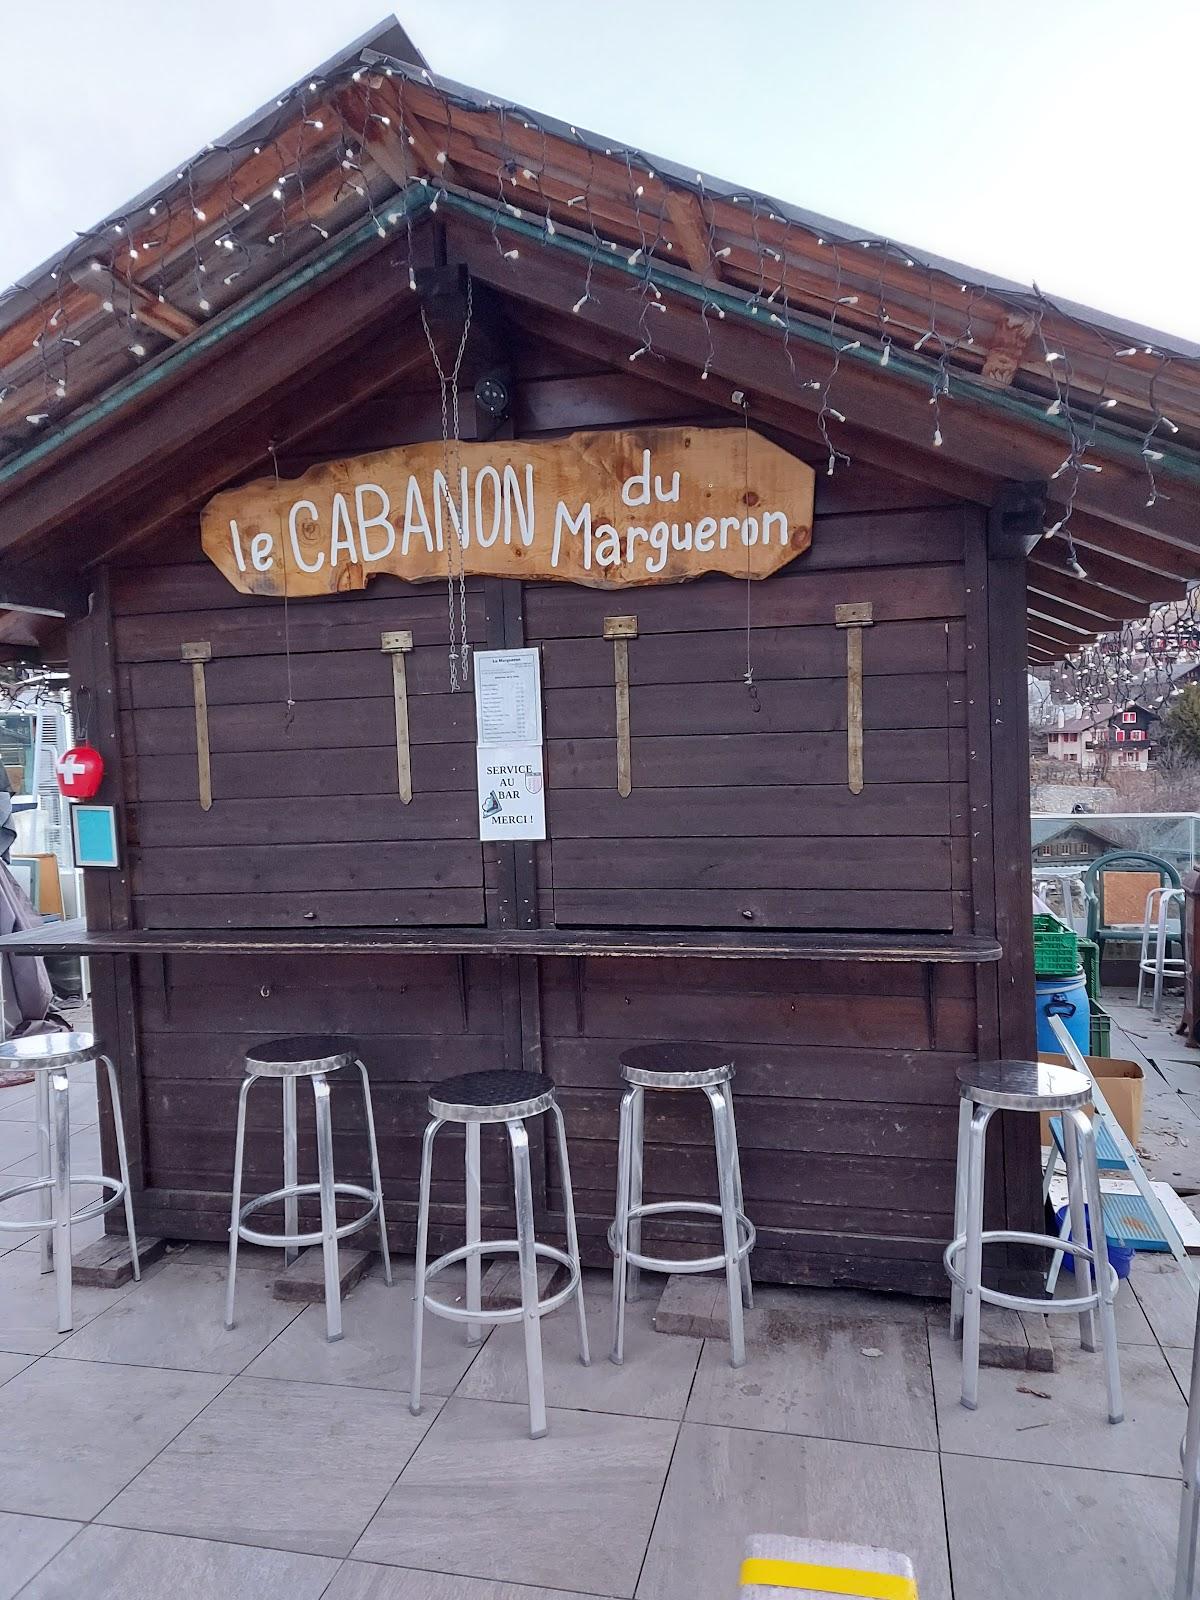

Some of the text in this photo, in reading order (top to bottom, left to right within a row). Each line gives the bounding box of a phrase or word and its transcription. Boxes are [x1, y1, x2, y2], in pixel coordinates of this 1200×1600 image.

[622, 448, 682, 507] du
[230, 463, 536, 573] le CABANON
[551, 500, 789, 573] Margueron
[486, 765, 533, 775] SERVICE
[499, 778, 515, 787] AU
[498, 790, 520, 800] BAR
[491, 815, 528, 825] MERCI
